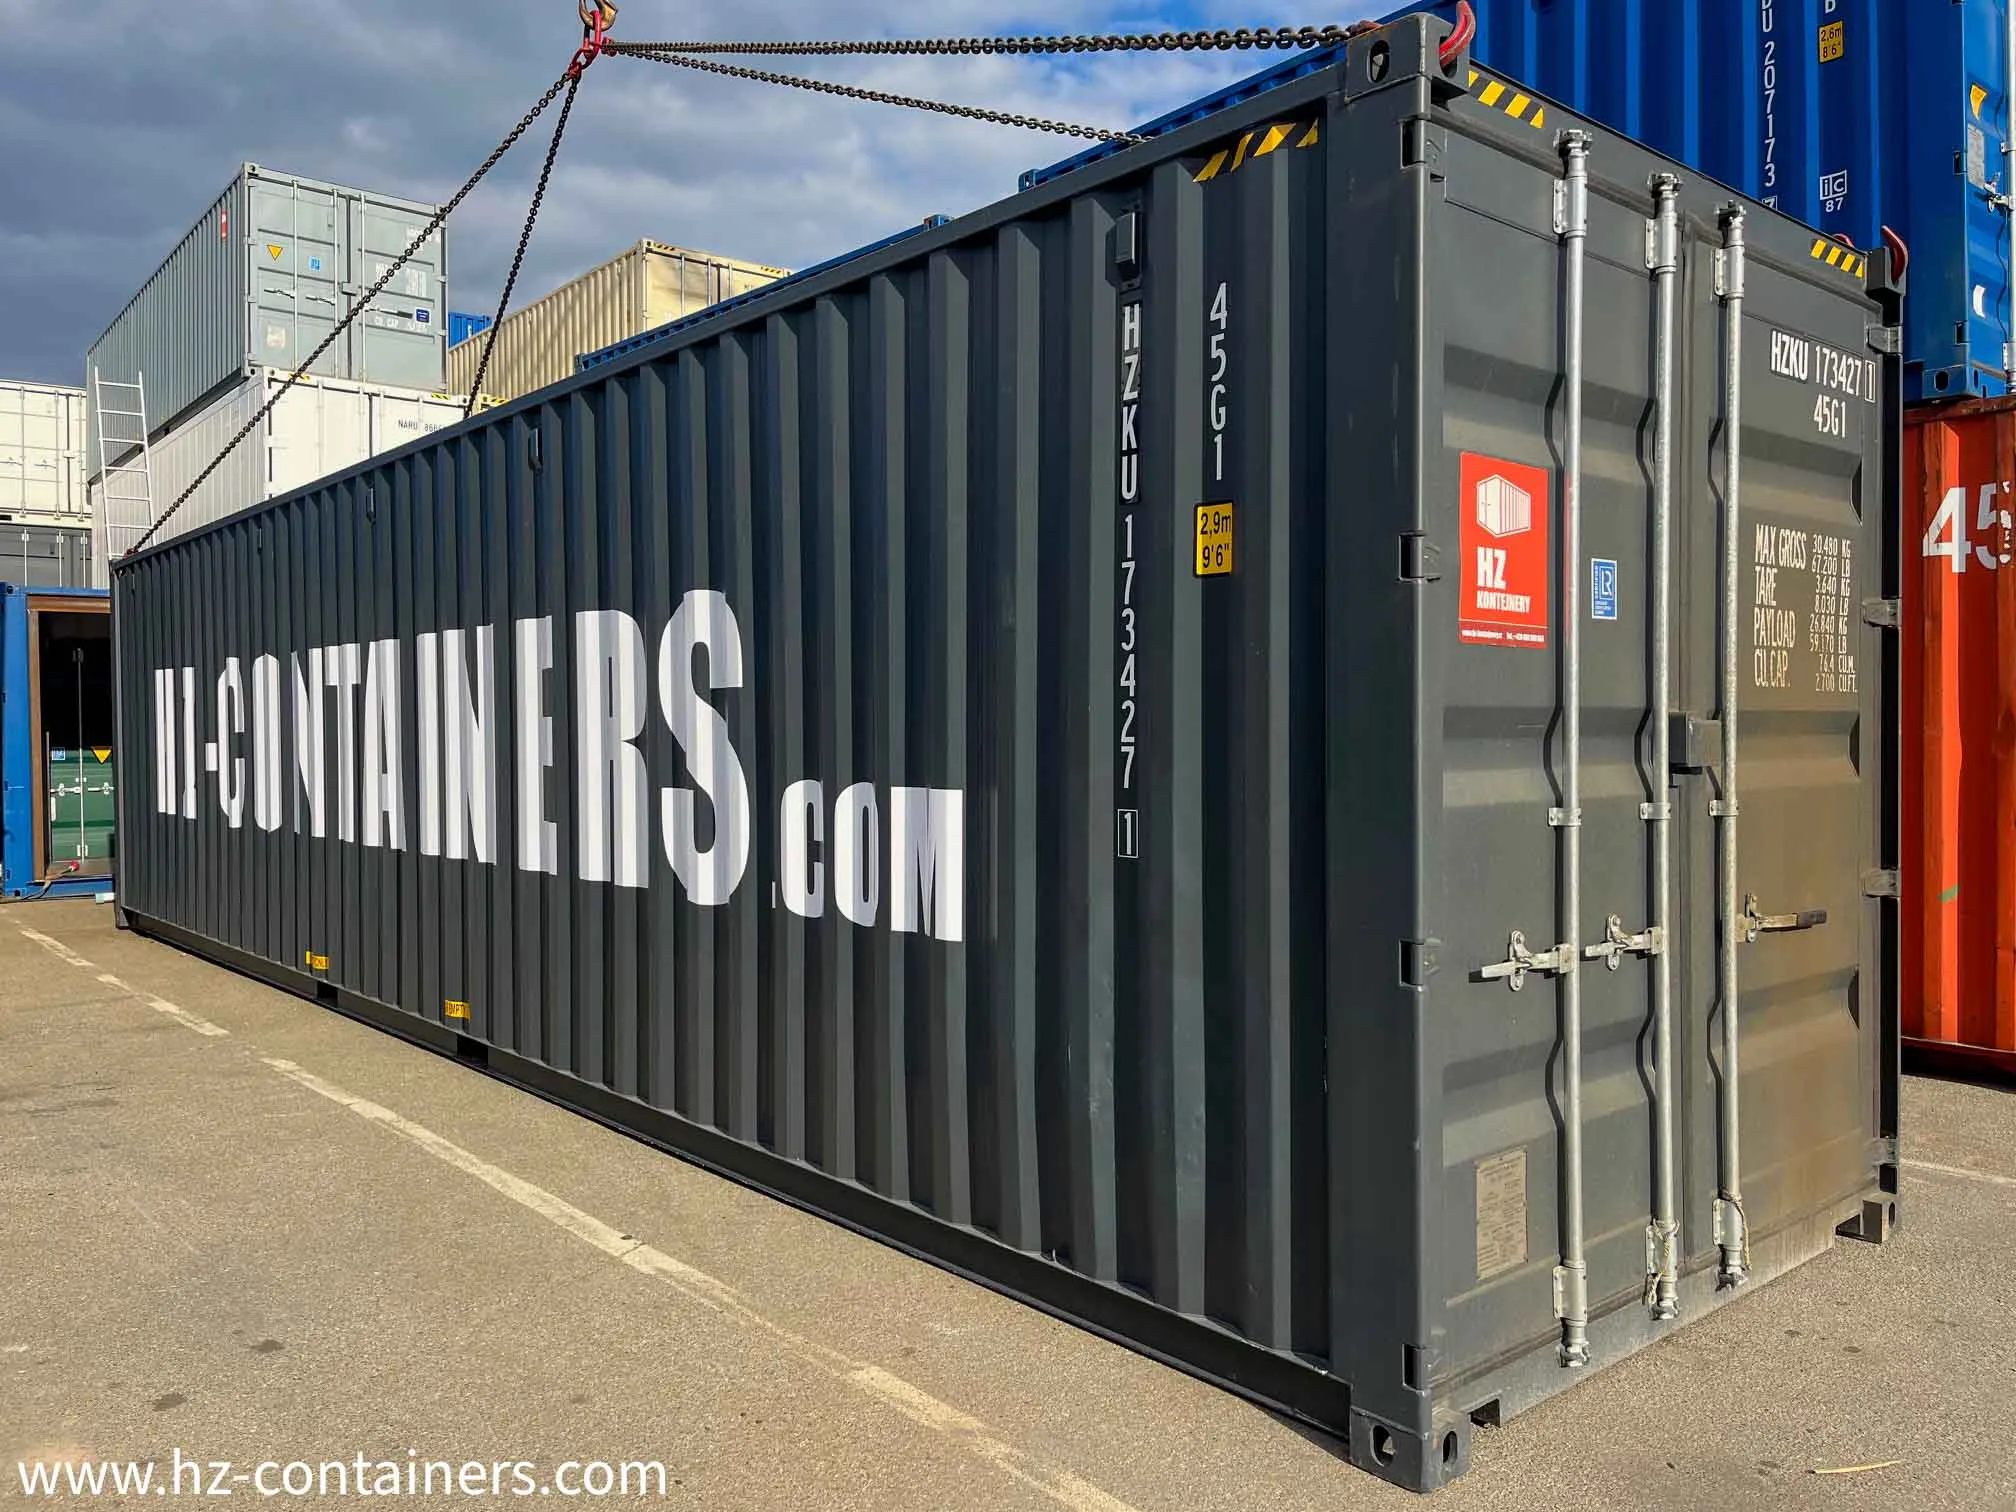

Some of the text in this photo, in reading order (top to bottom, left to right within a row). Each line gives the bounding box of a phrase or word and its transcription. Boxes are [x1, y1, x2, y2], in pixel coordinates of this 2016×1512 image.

[1764, 41, 1775, 187] 207173
[1825, 197, 1843, 212] 87
[1209, 282, 1228, 481] 45G1
[1771, 331, 1808, 381] HZKU
[1815, 346, 1862, 396] 173427
[1121, 303, 1140, 500] HZKU
[1814, 394, 1846, 438] 45G1
[1477, 546, 1506, 589] HZ
[1755, 524, 1777, 565] MAX
[1778, 528, 1807, 570] GROSS
[1841, 558, 1850, 577] LB
[1754, 567, 1778, 606] TARE
[1841, 578, 1850, 596] KG
[1754, 608, 1795, 648] PAYLOAD
[1838, 636, 1847, 654] LB
[1120, 514, 1136, 788] 173427
